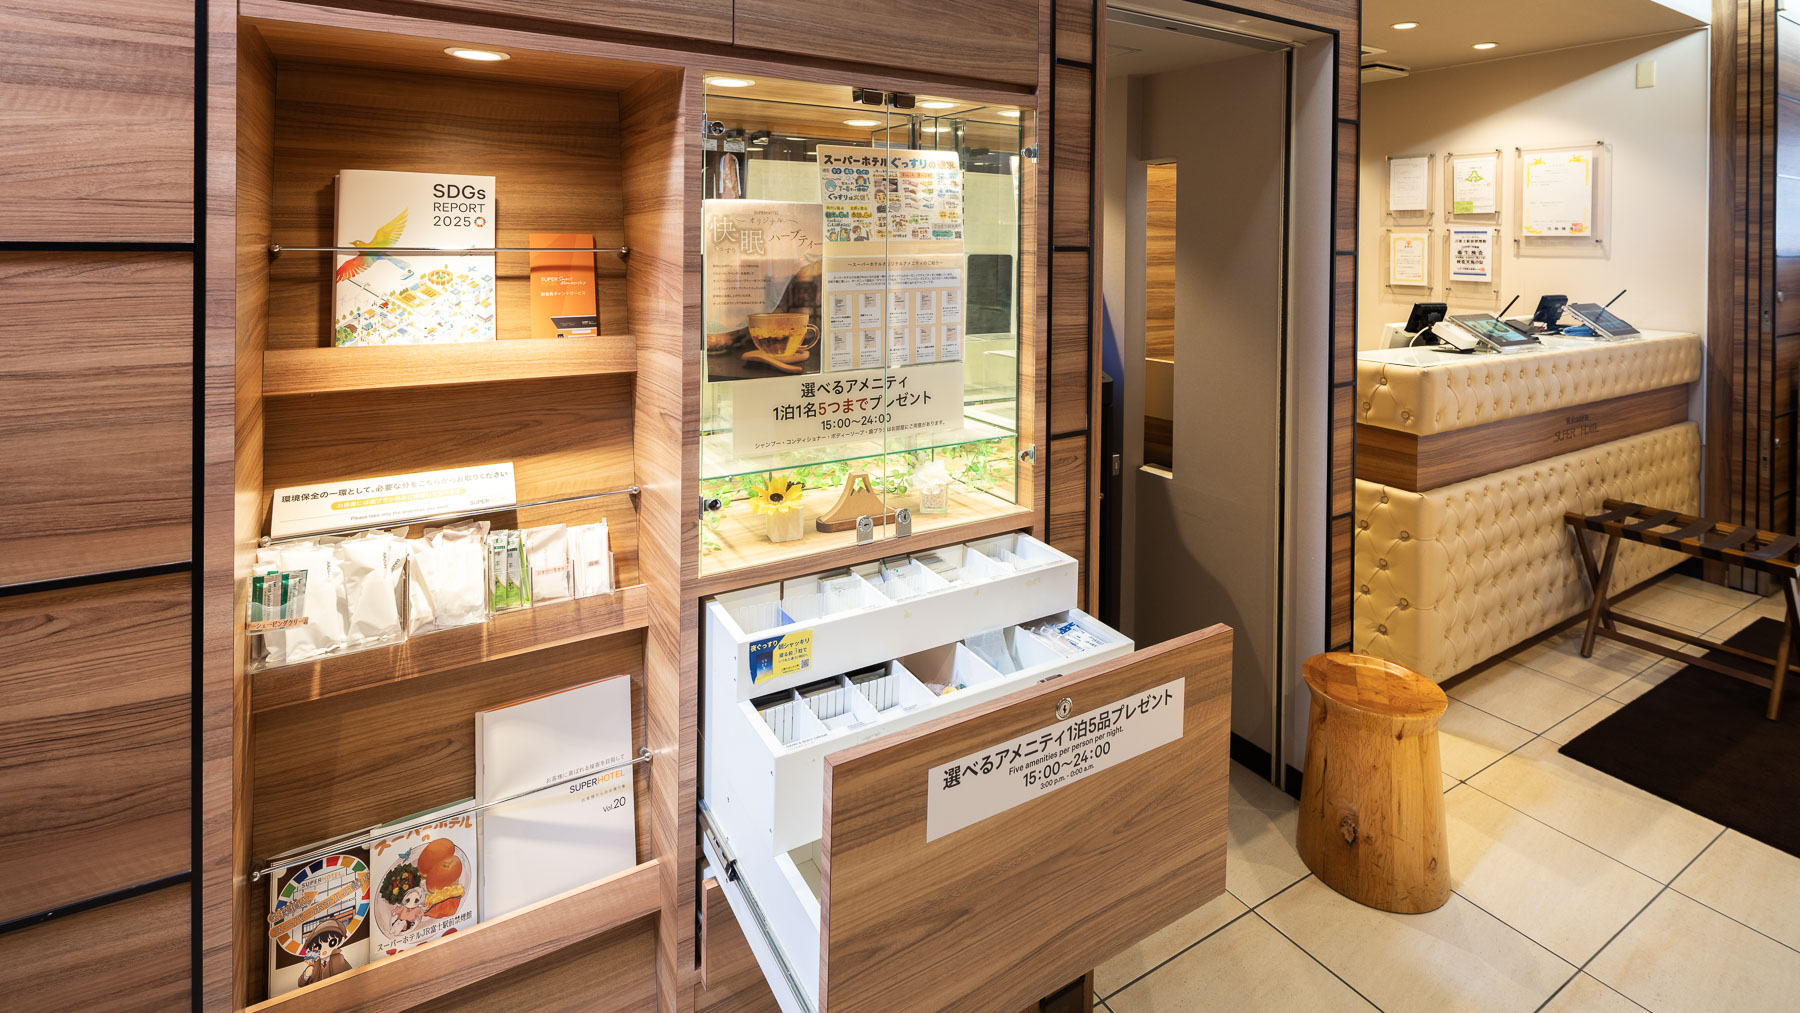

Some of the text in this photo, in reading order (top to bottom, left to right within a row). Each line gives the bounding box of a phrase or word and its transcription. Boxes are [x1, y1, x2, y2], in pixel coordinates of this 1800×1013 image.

[432, 183, 487, 201] SDGs
[432, 201, 486, 214] REPORT
[432, 215, 472, 228] 2025
[709, 215, 766, 256] 快眠
[768, 229, 823, 249] ハーブティー
[800, 375, 908, 399] 選べるアメニティ
[350, 513, 368, 521] Please
[942, 689, 1173, 791] 選べるアメニティ1泊5品プレゼント
[1008, 724, 1124, 776] Five amenities per person per night.
[569, 769, 625, 794] SUPERHOTEL
[1040, 780, 1053, 790] 3:00
[1053, 775, 1066, 786] p.m.
[1070, 767, 1083, 778] 0:00
[1083, 763, 1095, 773] a.m.
[602, 796, 627, 813] Vol.20
[373, 815, 473, 857] スーパーホテル
[301, 871, 342, 888] SUPERHOTEL
